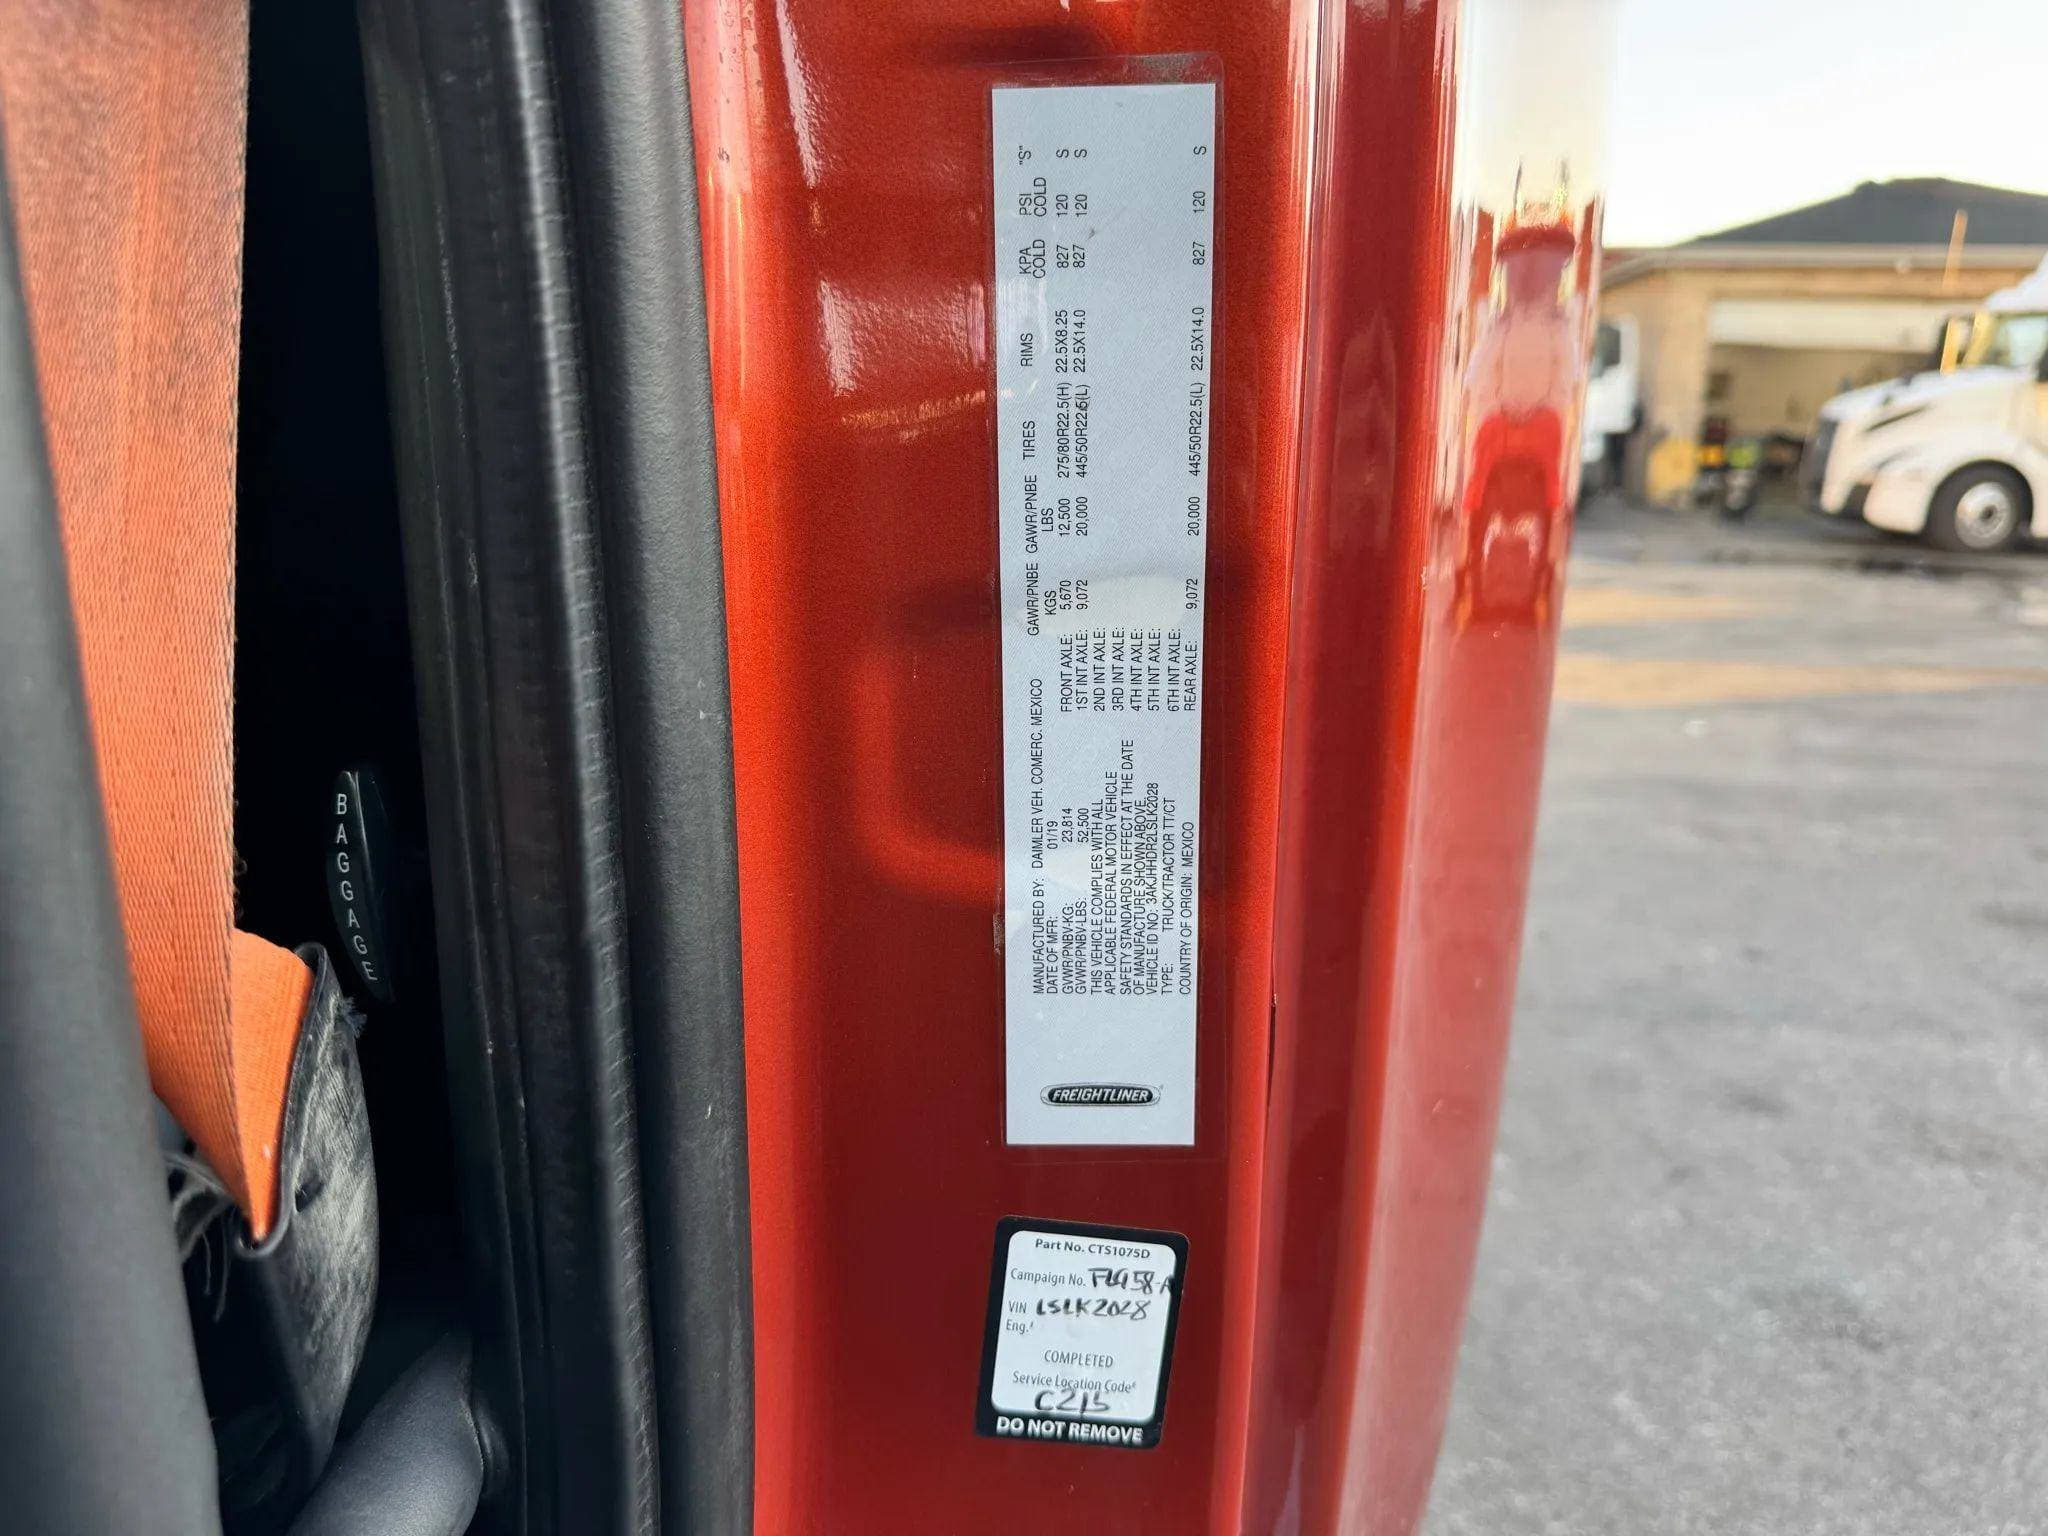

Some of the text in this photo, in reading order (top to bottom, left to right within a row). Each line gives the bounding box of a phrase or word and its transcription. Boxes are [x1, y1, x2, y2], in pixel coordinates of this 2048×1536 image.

[1074, 149, 1087, 158] S
[1075, 194, 1087, 217] 120
[1073, 244, 1085, 268] 827
[1074, 309, 1086, 373] 22.5X14.0
[1019, 145, 1039, 635] GAWR/PNBE GAWR/PNBE TIRES RIMS KPA PSI "S"
[1033, 177, 1056, 615] KGS LBS COLD COLD
[1056, 149, 1073, 712] FRONT AXLE: 5,670 12,500 275/80R22.5(H) 22.5X8.25 827 120 S
[1185, 146, 1206, 710] REAR AXLE: 9,072 20,000 445/50R22.5(L) 22.5X14.0 827 120 S
[1076, 497, 1089, 536] 20,000
[1076, 580, 1089, 610] 9,072
[1076, 629, 1088, 664] AXLE:
[1076, 666, 1088, 685] INT
[1094, 627, 1105, 711] 2ND INT AXLE:
[1112, 627, 1124, 711] 3RD INT AXLE:
[1131, 628, 1142, 711] 4TH INT AXLE:
[1148, 628, 1160, 711] 5TH INT AXLE:
[1168, 629, 1180, 711] 6TH INT AXLE:
[1076, 689, 1088, 710] 1ST
[1030, 678, 1044, 994] MANUFACTURED BY: DAIMLER VEH. COMERC. MEXICO
[1120, 740, 1133, 995] SAFETY STANDARDS IN EFFECT AT THE DATE
[335, 793, 379, 982] BAGGAGE
[1047, 821, 1058, 994] DATE OF MFR: 01/19
[1062, 808, 1074, 994] GVWR/PNBV-KG: 23,814
[1075, 808, 1090, 994] GVWR/PNBV-LBS: 52,500
[1091, 799, 1103, 995] THIS VEHICLE COMPLIES WITH ALL
[1105, 771, 1117, 995] APPLICABLE FEDERAL MOTOR VEHICLE
[1134, 797, 1146, 995] OF MANUFACTURE SHOWN ABOVE.
[1146, 782, 1158, 994] VEHICLE ID NO: 3AKJHHDR2LSLK2028
[1162, 797, 1175, 995] TYPE: TRUCK/TRACTOR TT/CT
[1180, 822, 1193, 995] COUNTRY OF ORIGIN: MEXICO
[1052, 1088, 1149, 1103] FREIGHTLINER
[1010, 1268, 1065, 1287] Campaign
[1068, 1275, 1087, 1288] No.
[1034, 1237, 1151, 1260] Part No. CTS1075D
[1008, 1300, 1027, 1315] VIN
[1012, 1371, 1052, 1386] Service
[1054, 1374, 1102, 1392] Location
[1043, 1349, 1114, 1369] COMPLETED
[995, 1415, 1145, 1446] DO NOT REMOVE
